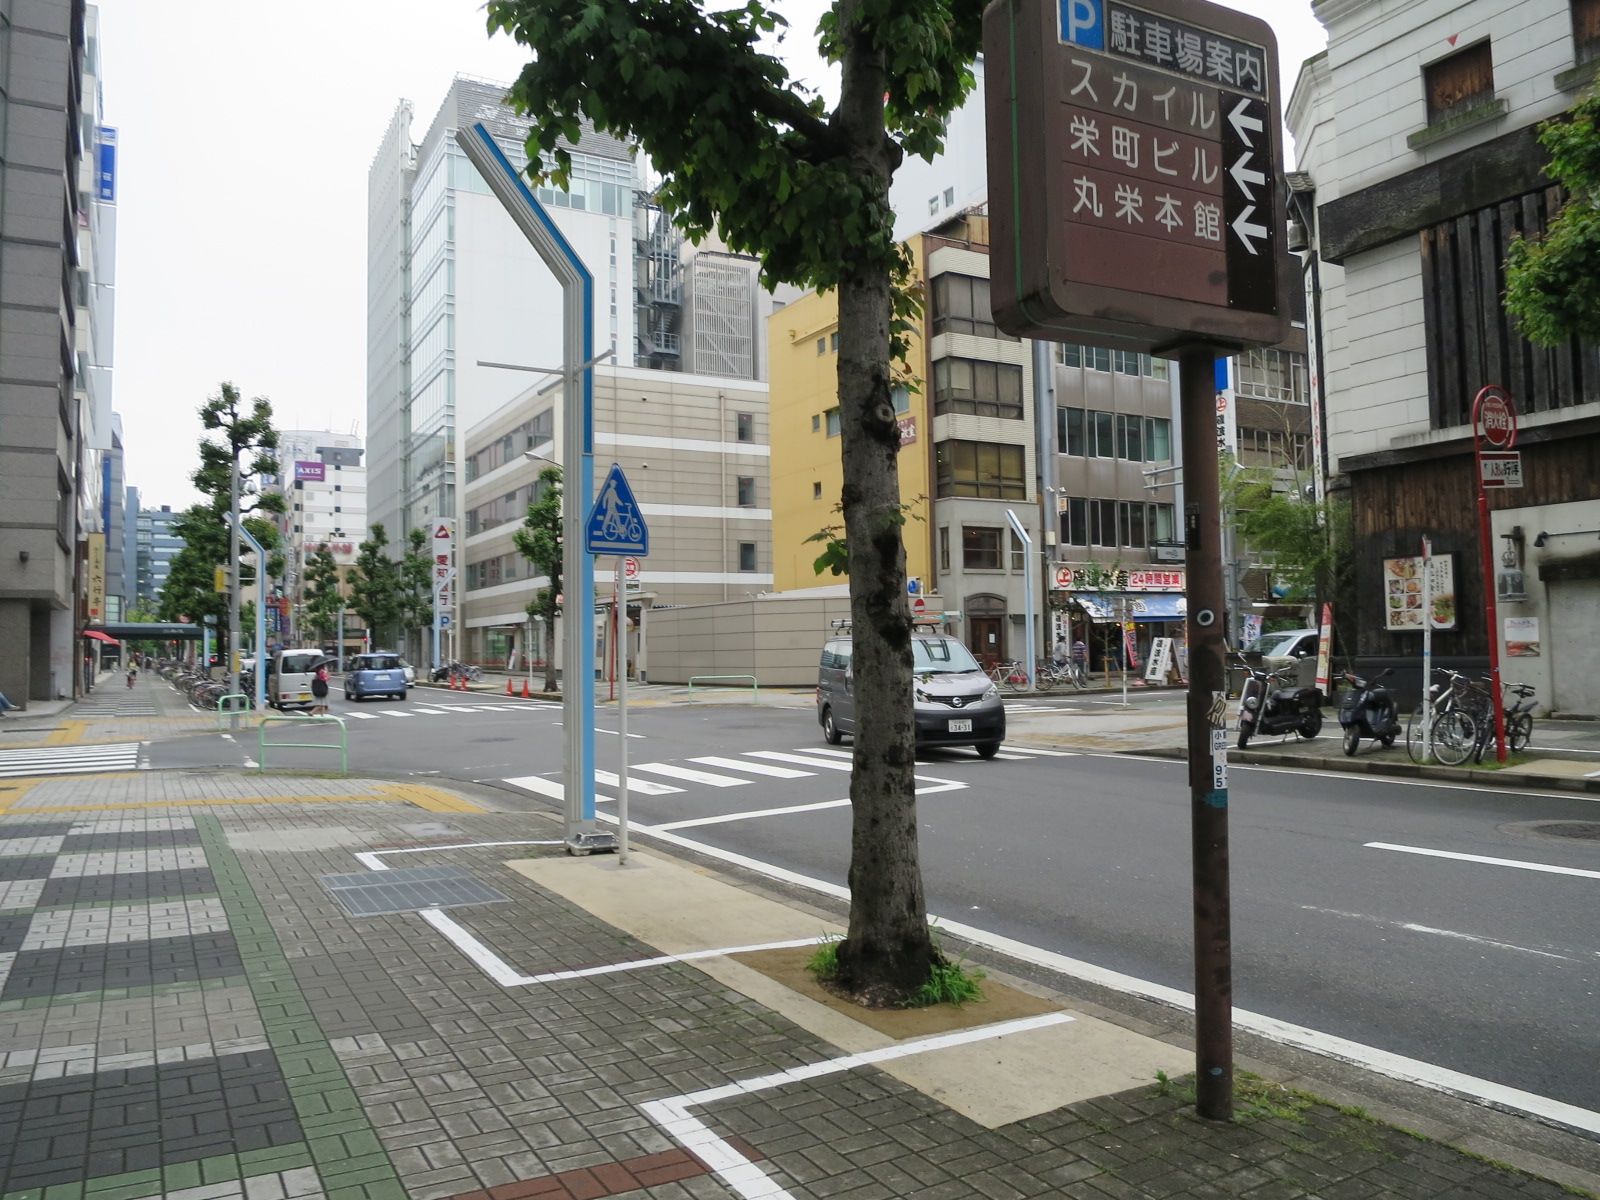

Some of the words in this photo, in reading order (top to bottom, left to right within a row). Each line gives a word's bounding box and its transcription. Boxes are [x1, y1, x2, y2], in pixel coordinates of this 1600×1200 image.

[1067, 0, 1097, 42] P
[1111, 9, 1261, 93] 駐車場案内
[1070, 58, 1216, 130] スカイル
[1070, 115, 1218, 185] 栄町ビル
[1072, 175, 1220, 242] 丸栄本館
[1484, 411, 1508, 430] 消火栓
[297, 467, 321, 475] AXIS
[1131, 572, 1180, 585] 24時間営業
[441, 616, 449, 628] P
